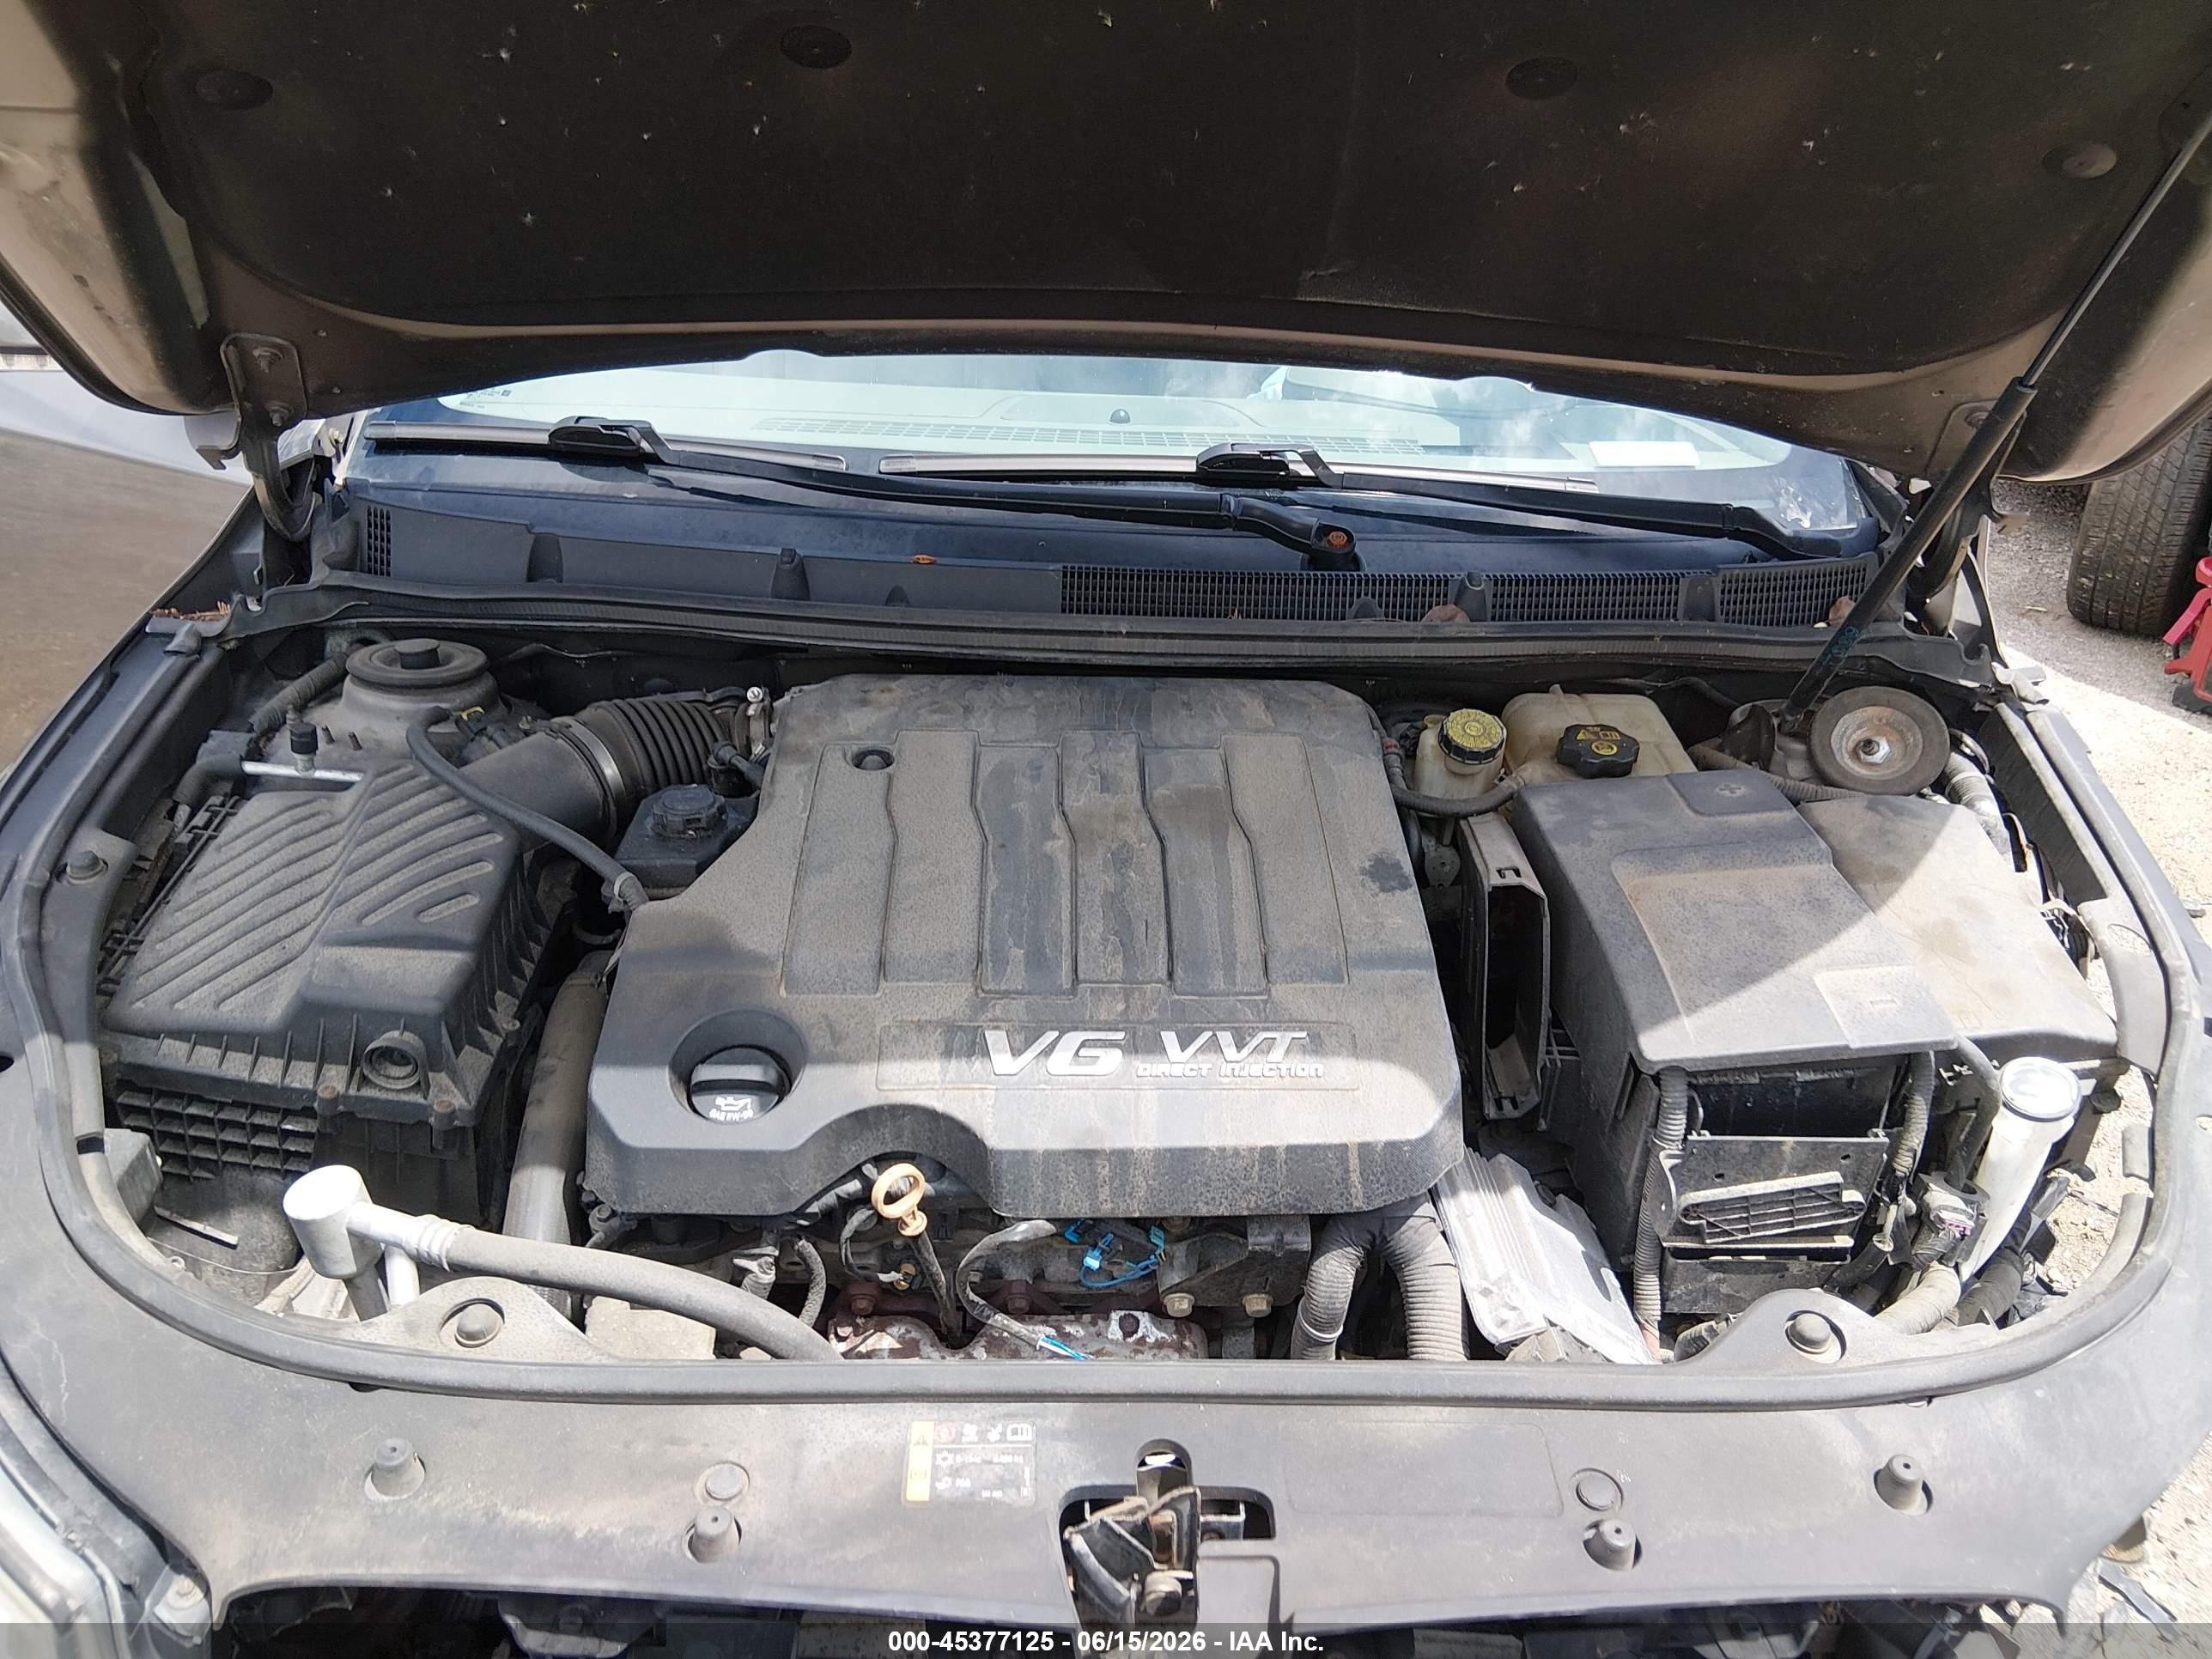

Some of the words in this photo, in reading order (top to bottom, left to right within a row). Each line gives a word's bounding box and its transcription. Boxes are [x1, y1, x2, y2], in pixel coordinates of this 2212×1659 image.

[984, 1030, 1126, 1076] V6
[1160, 1030, 1308, 1063] VVT
[1136, 1063, 1212, 1078] DIRECT
[1219, 1063, 1323, 1078] INJECTION
